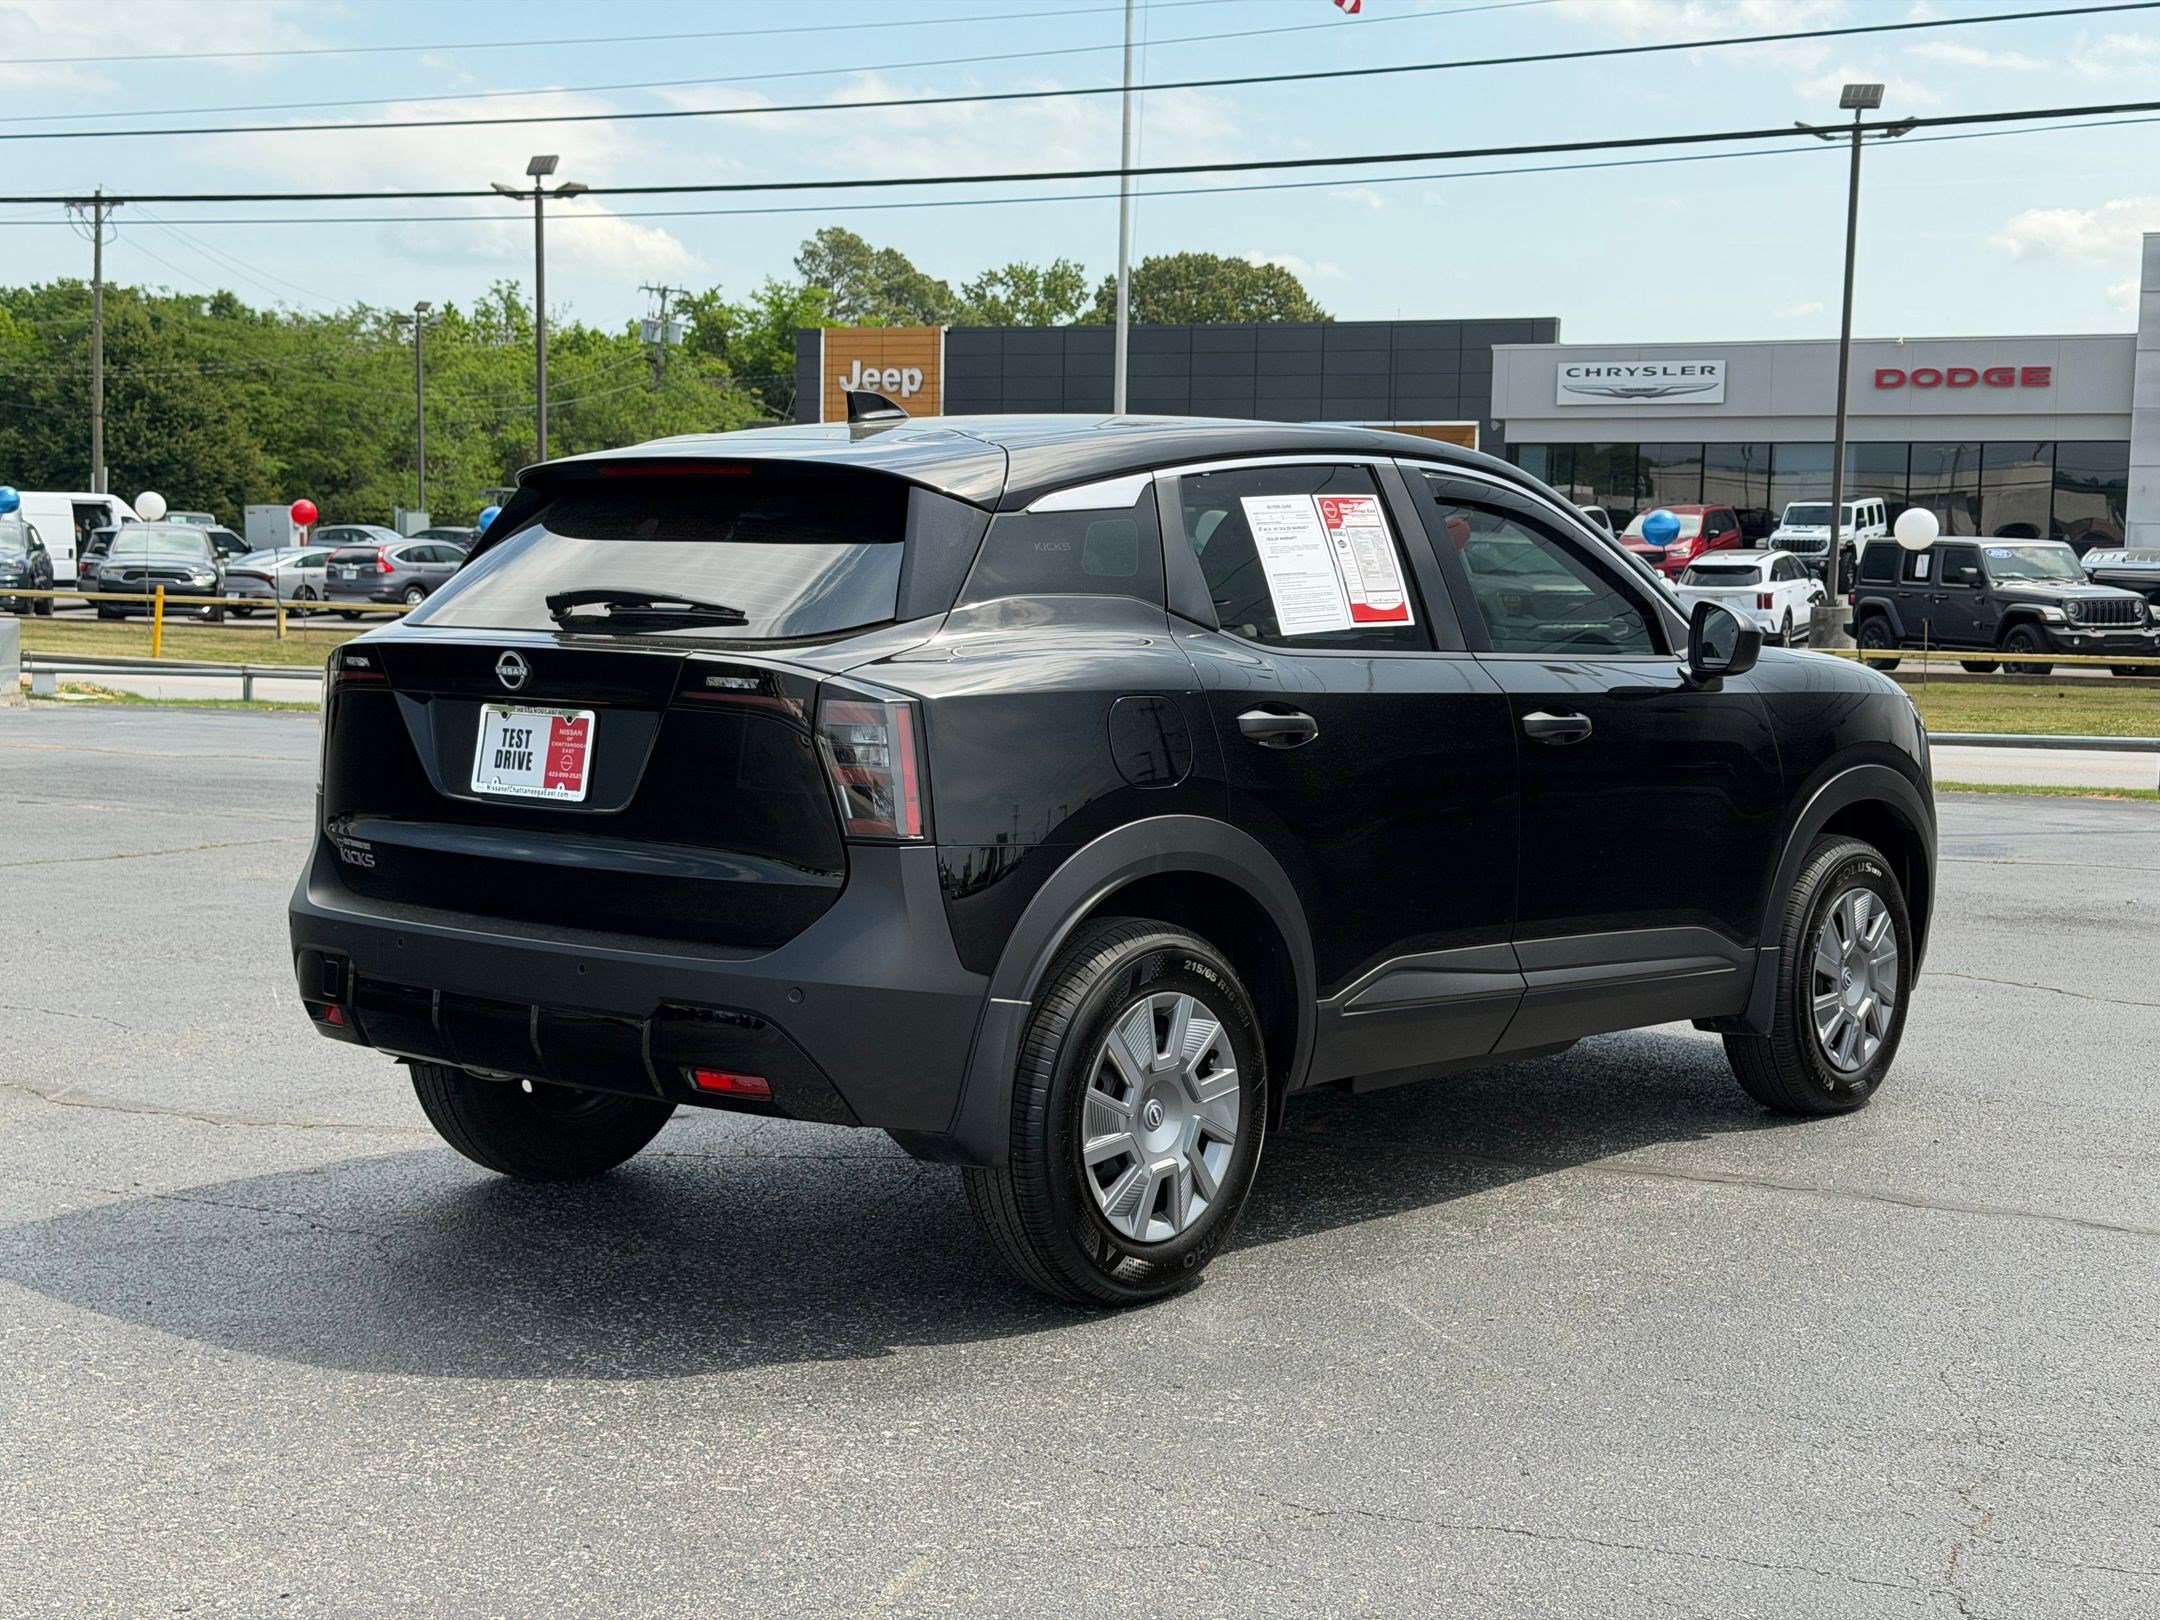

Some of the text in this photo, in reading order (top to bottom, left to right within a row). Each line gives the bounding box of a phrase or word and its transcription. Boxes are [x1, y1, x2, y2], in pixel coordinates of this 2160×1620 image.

[839, 360, 923, 398] Jeep
[1565, 365, 1717, 378] CHRYSLER
[1874, 366, 2052, 390] DODGE
[1033, 542, 1071, 552] KICKS
[502, 728, 533, 749] TEST
[559, 729, 583, 737] NISSAN
[494, 749, 534, 771] DRIVE
[340, 847, 376, 868] KICKS
[1183, 960, 1218, 982] 215/65
